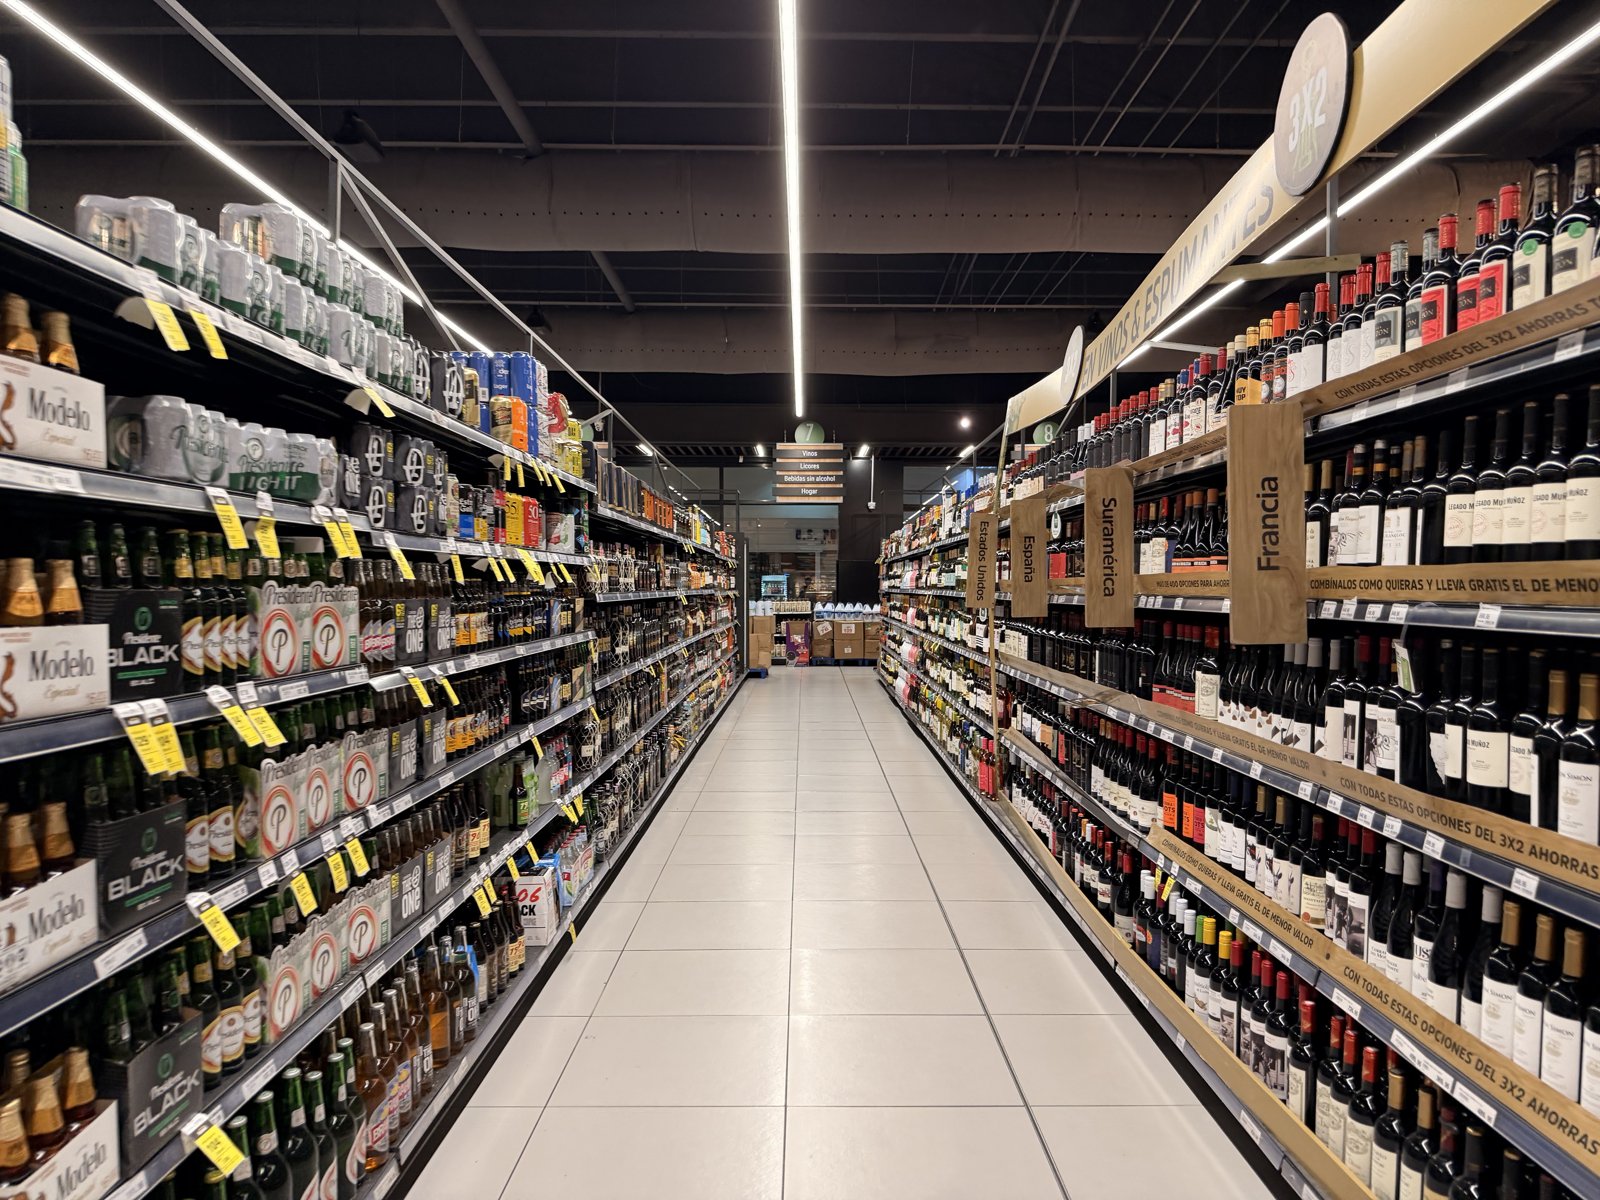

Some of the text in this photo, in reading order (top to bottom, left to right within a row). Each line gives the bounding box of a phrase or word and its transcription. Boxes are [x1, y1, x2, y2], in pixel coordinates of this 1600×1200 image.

[1288, 66, 1328, 152] 3X2
[1081, 184, 1274, 390] EN VINOS & ESPUMANTES
[1334, 387, 1351, 400] CON
[1351, 378, 1382, 396] TODAS
[1380, 369, 1410, 385] ESTAS
[1409, 349, 1464, 375] OPCIONES
[1462, 342, 1488, 357] DEL
[1489, 331, 1516, 347] 3X2
[1518, 304, 1590, 335] AHORRAS
[27, 387, 92, 431] Modelo
[806, 423, 814, 441] 7
[1044, 424, 1053, 442] 8
[801, 488, 818, 496] Hogar
[1449, 503, 1467, 511] LEGADO
[1102, 497, 1118, 597] Suramérica
[1256, 476, 1281, 571] Francia
[976, 521, 990, 601] Estados Unidos
[1022, 535, 1036, 583] España
[1179, 580, 1200, 588] OPCIONES
[1310, 577, 1600, 593] COMBÍNALOS COMO QUIERAS Y LLEVA GRATIS EL DE MENO
[28, 649, 93, 682] Modelo
[108, 644, 180, 668] BLACK
[1217, 729, 1231, 742] LLEVA
[1232, 735, 1250, 749] GRATIS
[1250, 741, 1258, 750] EL
[1258, 744, 1266, 754] DE
[1266, 746, 1288, 761] MENOR
[1289, 754, 1310, 770] VALOR
[1340, 777, 1357, 791] CON
[1358, 782, 1386, 802] TODAS
[1388, 793, 1415, 814] ESTAS
[1417, 806, 1472, 834] OPCIONES
[1475, 825, 1496, 844] DEL
[1499, 834, 1525, 854] 3X2
[1528, 845, 1599, 880] AHORRAS
[108, 854, 184, 901] BLACK
[1185, 853, 1199, 868] COMO
[1198, 861, 1217, 881] QUIERAS
[1220, 877, 1236, 894] LLEVA
[1236, 888, 1254, 906] GRATIS
[1254, 901, 1261, 911] EL
[1262, 907, 1271, 919] DE
[1270, 913, 1292, 935] MENOR
[1292, 926, 1314, 949] VALOR
[28, 894, 85, 944] Modelo
[1343, 966, 1600, 1156] CON TODAS ESTAS OPCIONES DEL 3X2 AHORRAS
[134, 1068, 201, 1138] BLACK
[55, 1140, 107, 1200] Modelo
